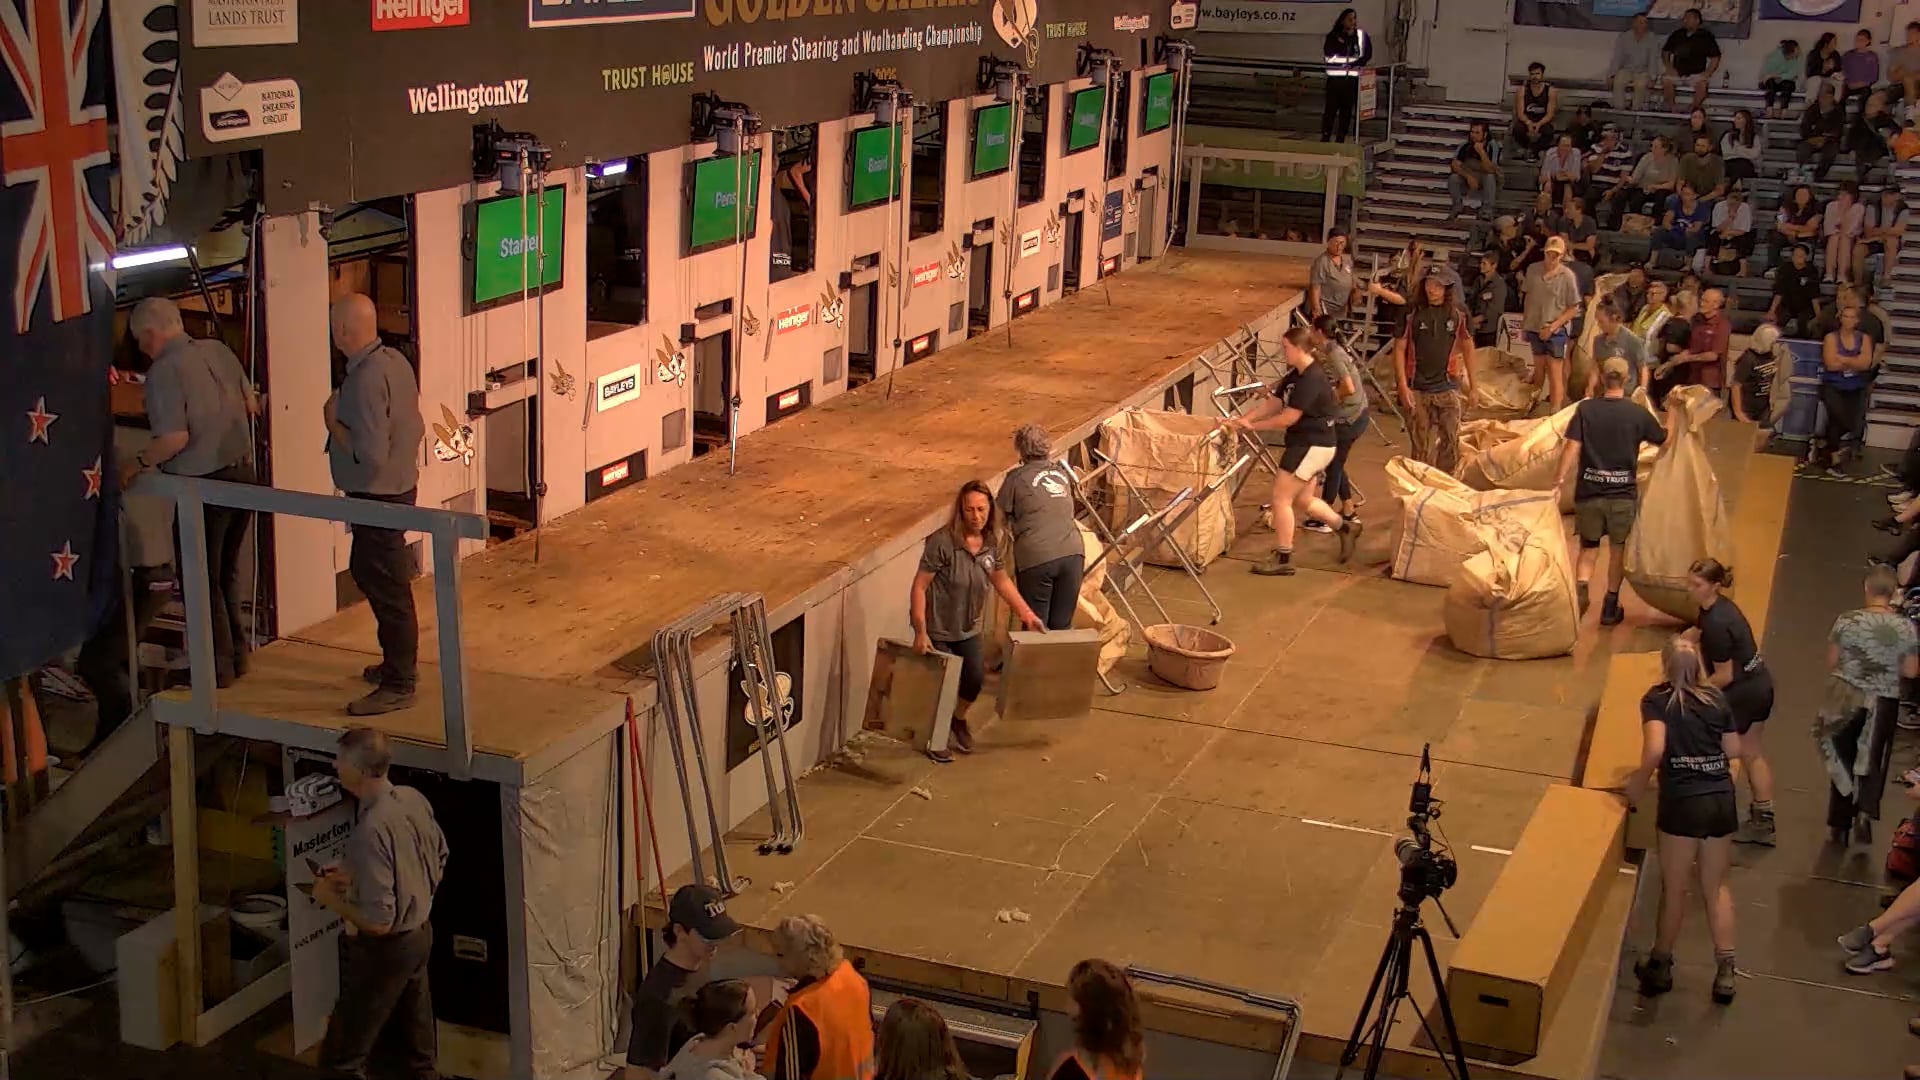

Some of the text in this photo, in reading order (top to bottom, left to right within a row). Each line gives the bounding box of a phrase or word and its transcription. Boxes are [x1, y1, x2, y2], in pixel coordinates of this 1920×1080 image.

[209, 9, 285, 26] LANDS TRUST
[703, 20, 982, 72] World Premier Shearing and Woolhandling Championship
[602, 61, 695, 91] TRUST HOUSE
[408, 79, 529, 114] WellingtonNZ
